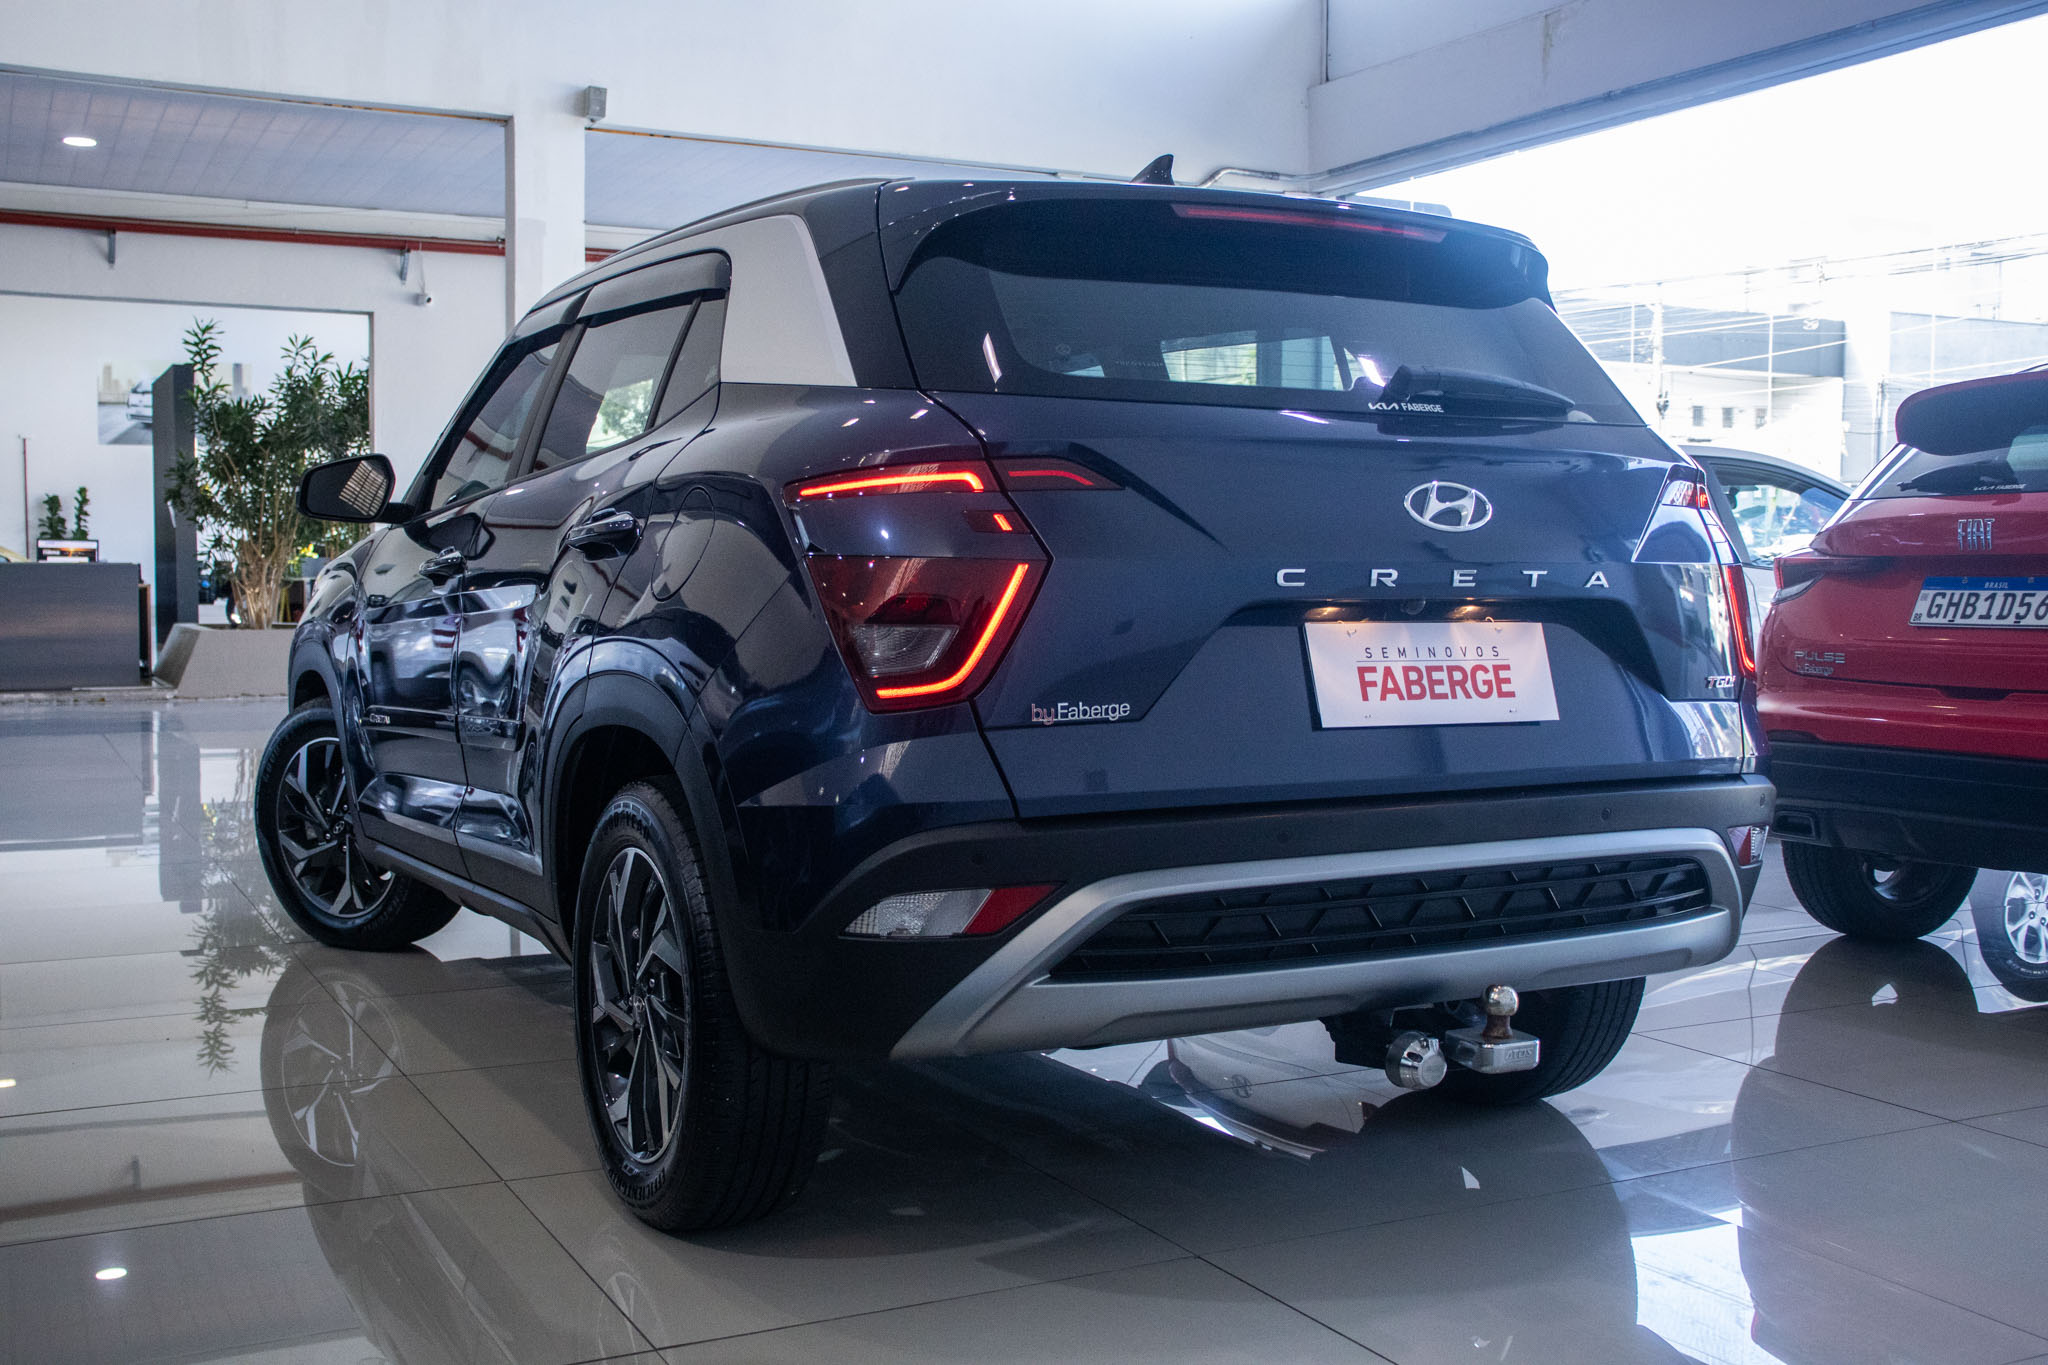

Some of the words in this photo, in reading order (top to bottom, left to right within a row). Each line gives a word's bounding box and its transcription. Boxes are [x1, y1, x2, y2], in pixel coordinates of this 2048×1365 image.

[1400, 402, 1445, 413] FABERGE
[1957, 518, 1996, 550] FIAT
[1276, 568, 1610, 588] CRETA
[1926, 591, 2048, 621] GHB1D56
[1364, 645, 1500, 659] SEMINOVOS
[1356, 663, 1517, 702] FABERGE
